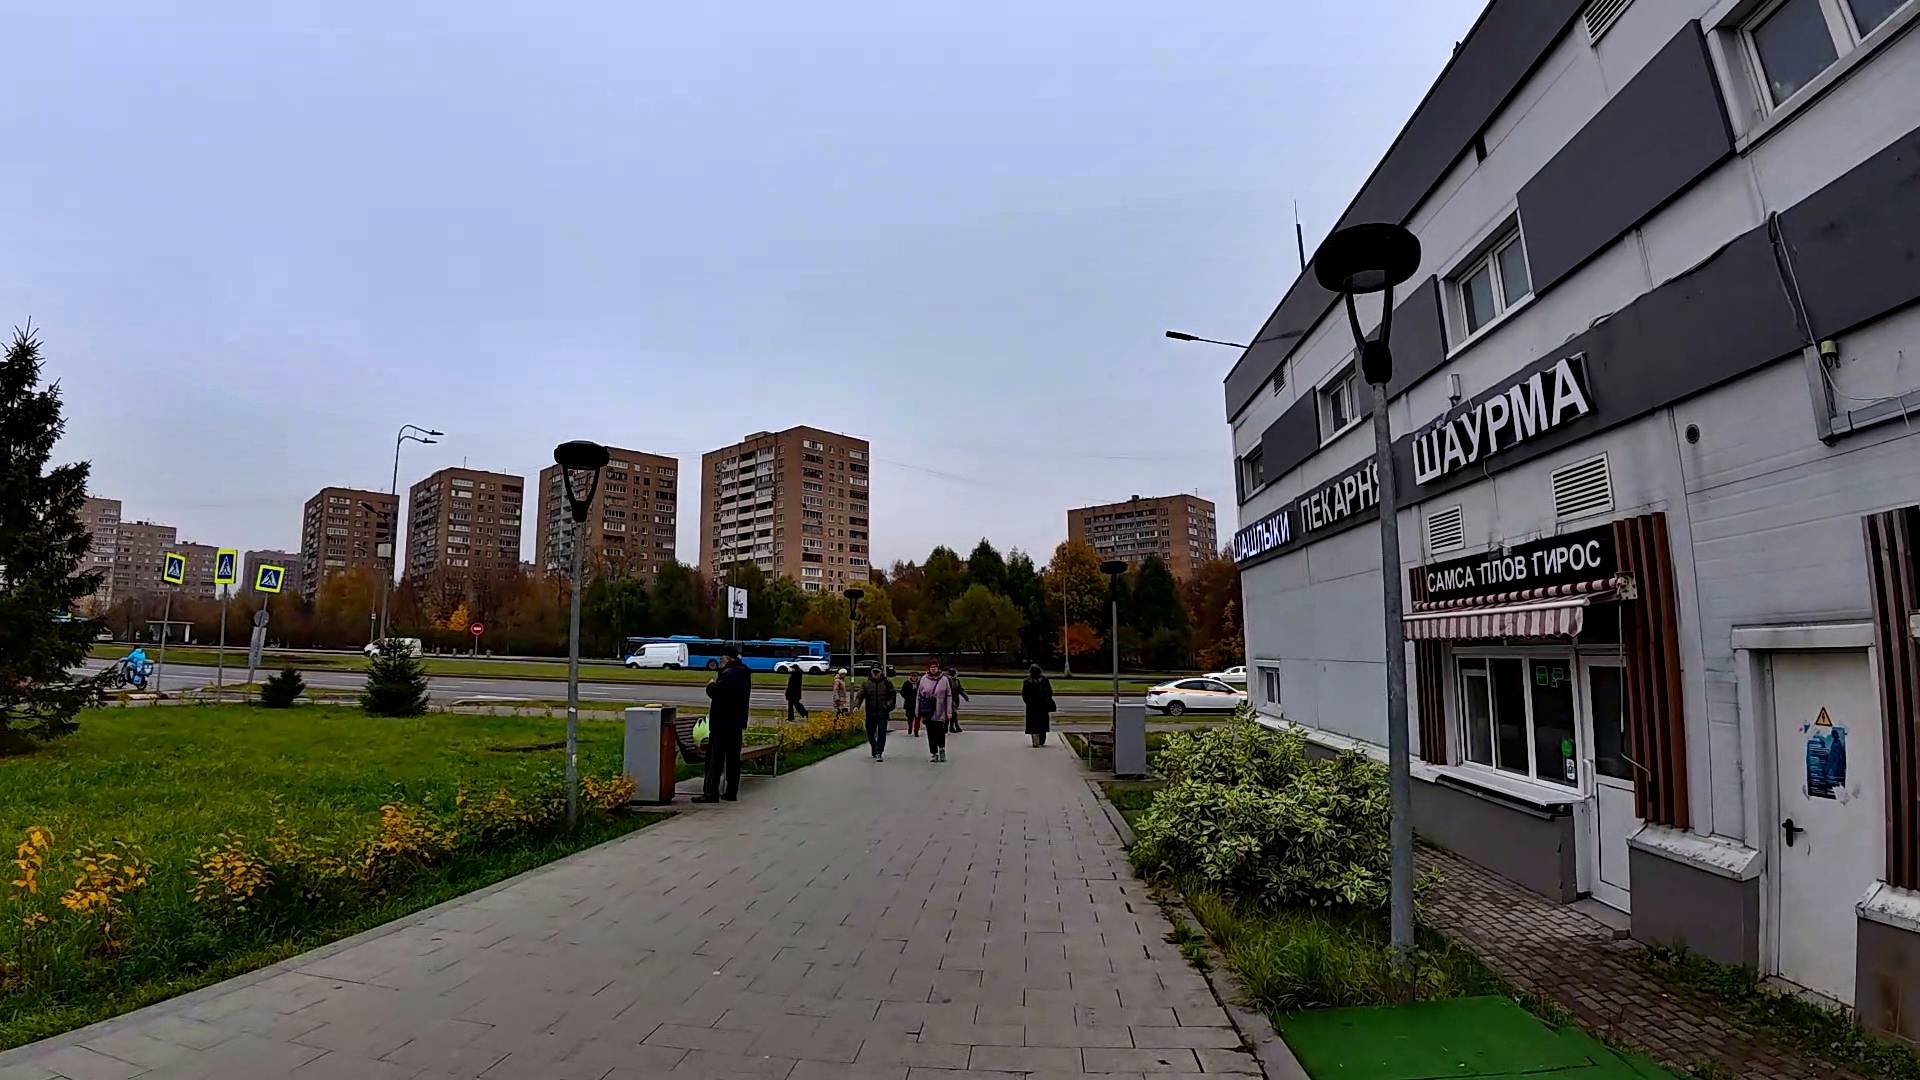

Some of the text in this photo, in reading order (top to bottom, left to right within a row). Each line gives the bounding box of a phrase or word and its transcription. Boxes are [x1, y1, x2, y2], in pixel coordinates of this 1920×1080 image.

[1412, 358, 1589, 486] ШАУРМА
[1233, 511, 1290, 563] ШАШЛЫКИ
[1427, 540, 1601, 592] САМСА ПЛОВ ГИРОС
